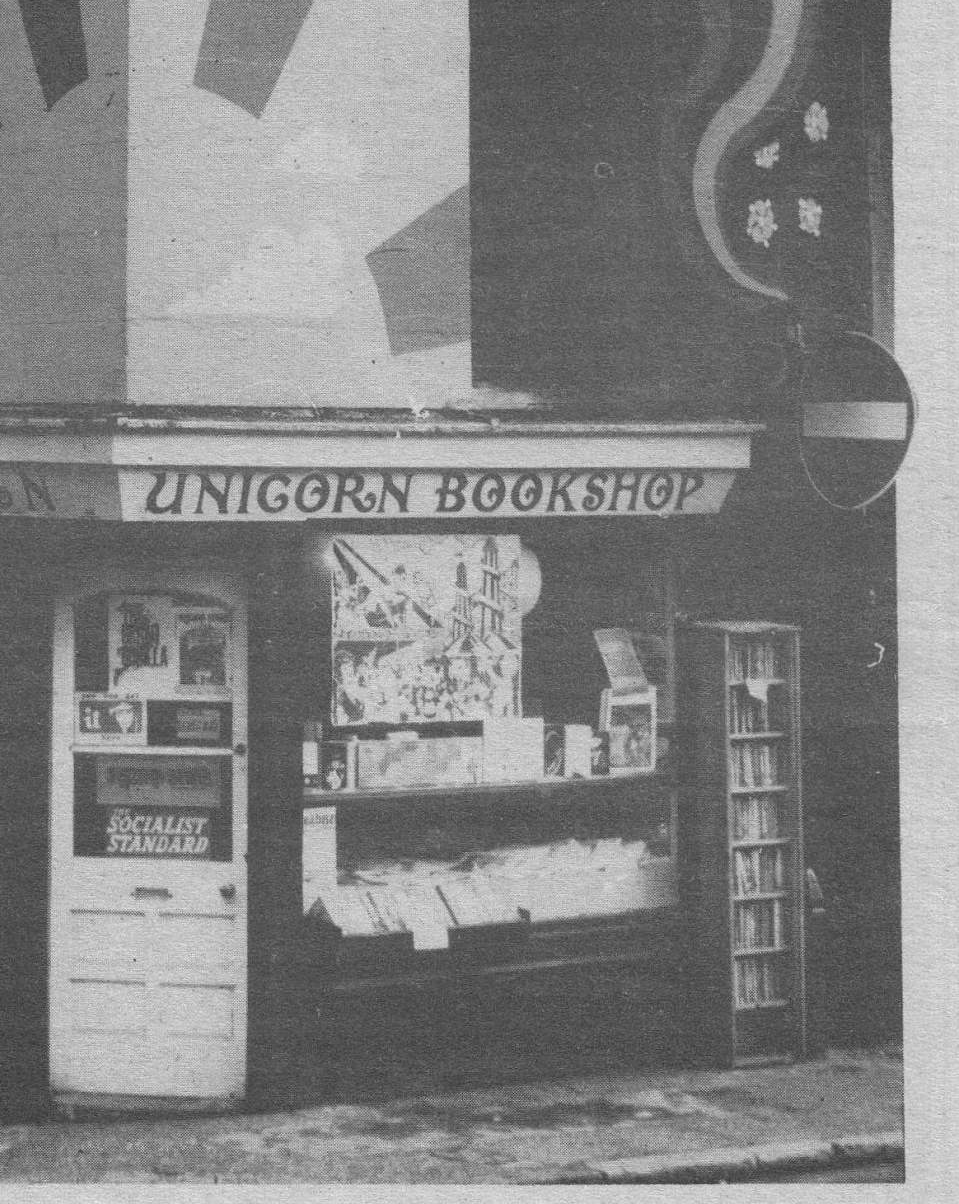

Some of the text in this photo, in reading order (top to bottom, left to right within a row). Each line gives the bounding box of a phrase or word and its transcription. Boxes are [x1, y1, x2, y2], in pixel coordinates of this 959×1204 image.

[145, 471, 704, 514] UNICORN BOOKSHOP
[106, 815, 210, 835] SOCIALIST
[106, 834, 210, 853] STANDARD
